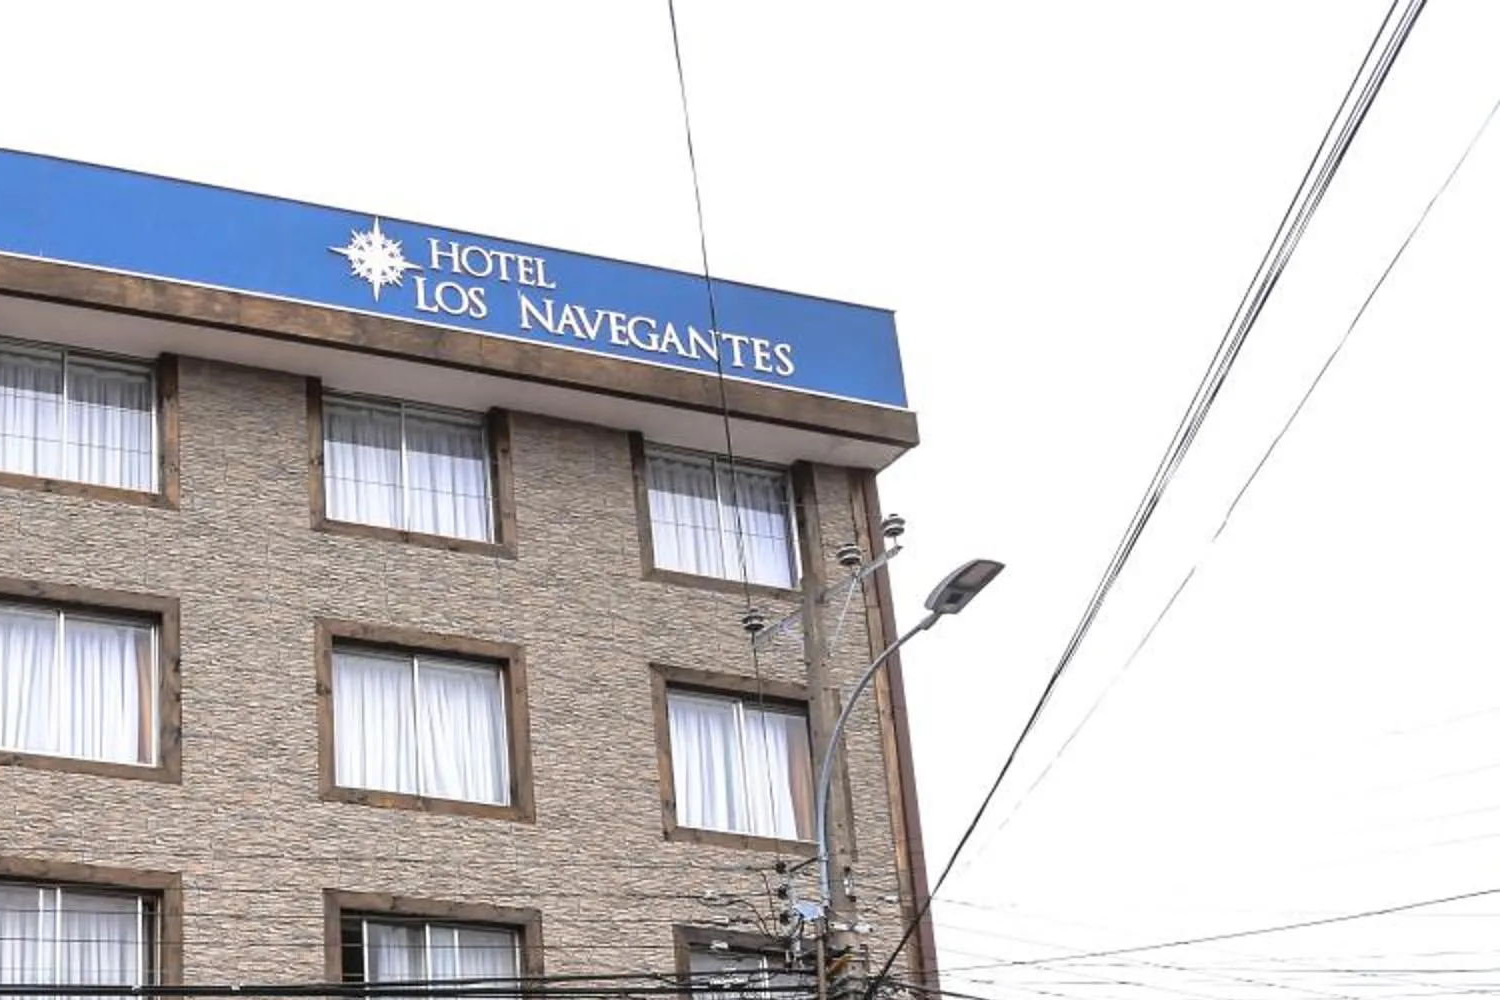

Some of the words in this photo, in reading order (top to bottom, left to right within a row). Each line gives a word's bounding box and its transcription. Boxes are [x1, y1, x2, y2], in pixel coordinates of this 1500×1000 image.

[428, 238, 556, 289] HOTEL
[414, 276, 487, 318] LOS
[518, 290, 795, 376] NAVEGANTES
